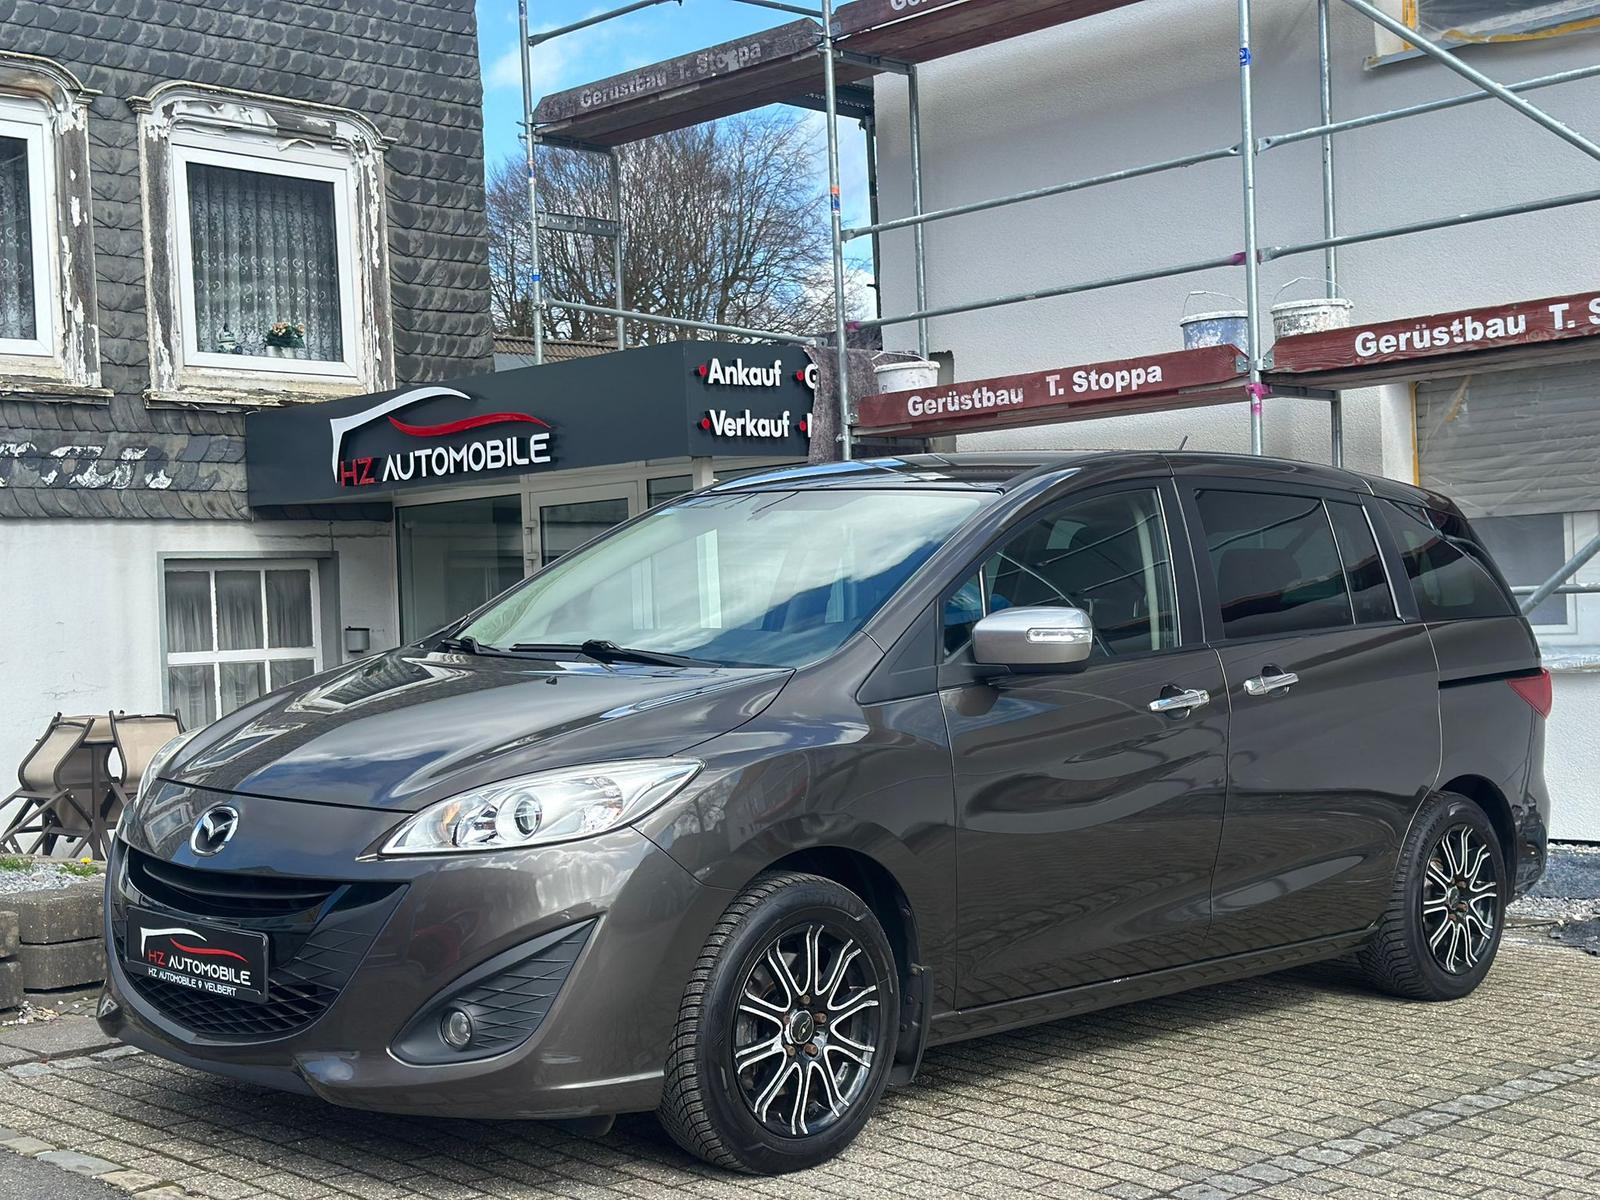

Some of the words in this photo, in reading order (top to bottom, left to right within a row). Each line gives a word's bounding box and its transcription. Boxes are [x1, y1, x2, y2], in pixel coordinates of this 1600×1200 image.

[1355, 314, 1526, 357] Gerüstbau
[1548, 303, 1576, 330] T.
[707, 358, 782, 387] Ankauf
[907, 386, 1024, 416] Gerüstbau
[1046, 374, 1065, 397] T.
[1072, 365, 1163, 393] Stoppa
[709, 409, 790, 438] Verkauf
[340, 456, 377, 488] HZ
[382, 432, 551, 482] AUTOMOBILE
[148, 949, 166, 966] HZ
[168, 955, 251, 986] AUTOMOBILE
[148, 967, 158, 978] HZ
[158, 971, 197, 988] AUTOMOBILE
[204, 981, 237, 997] VELBERT
